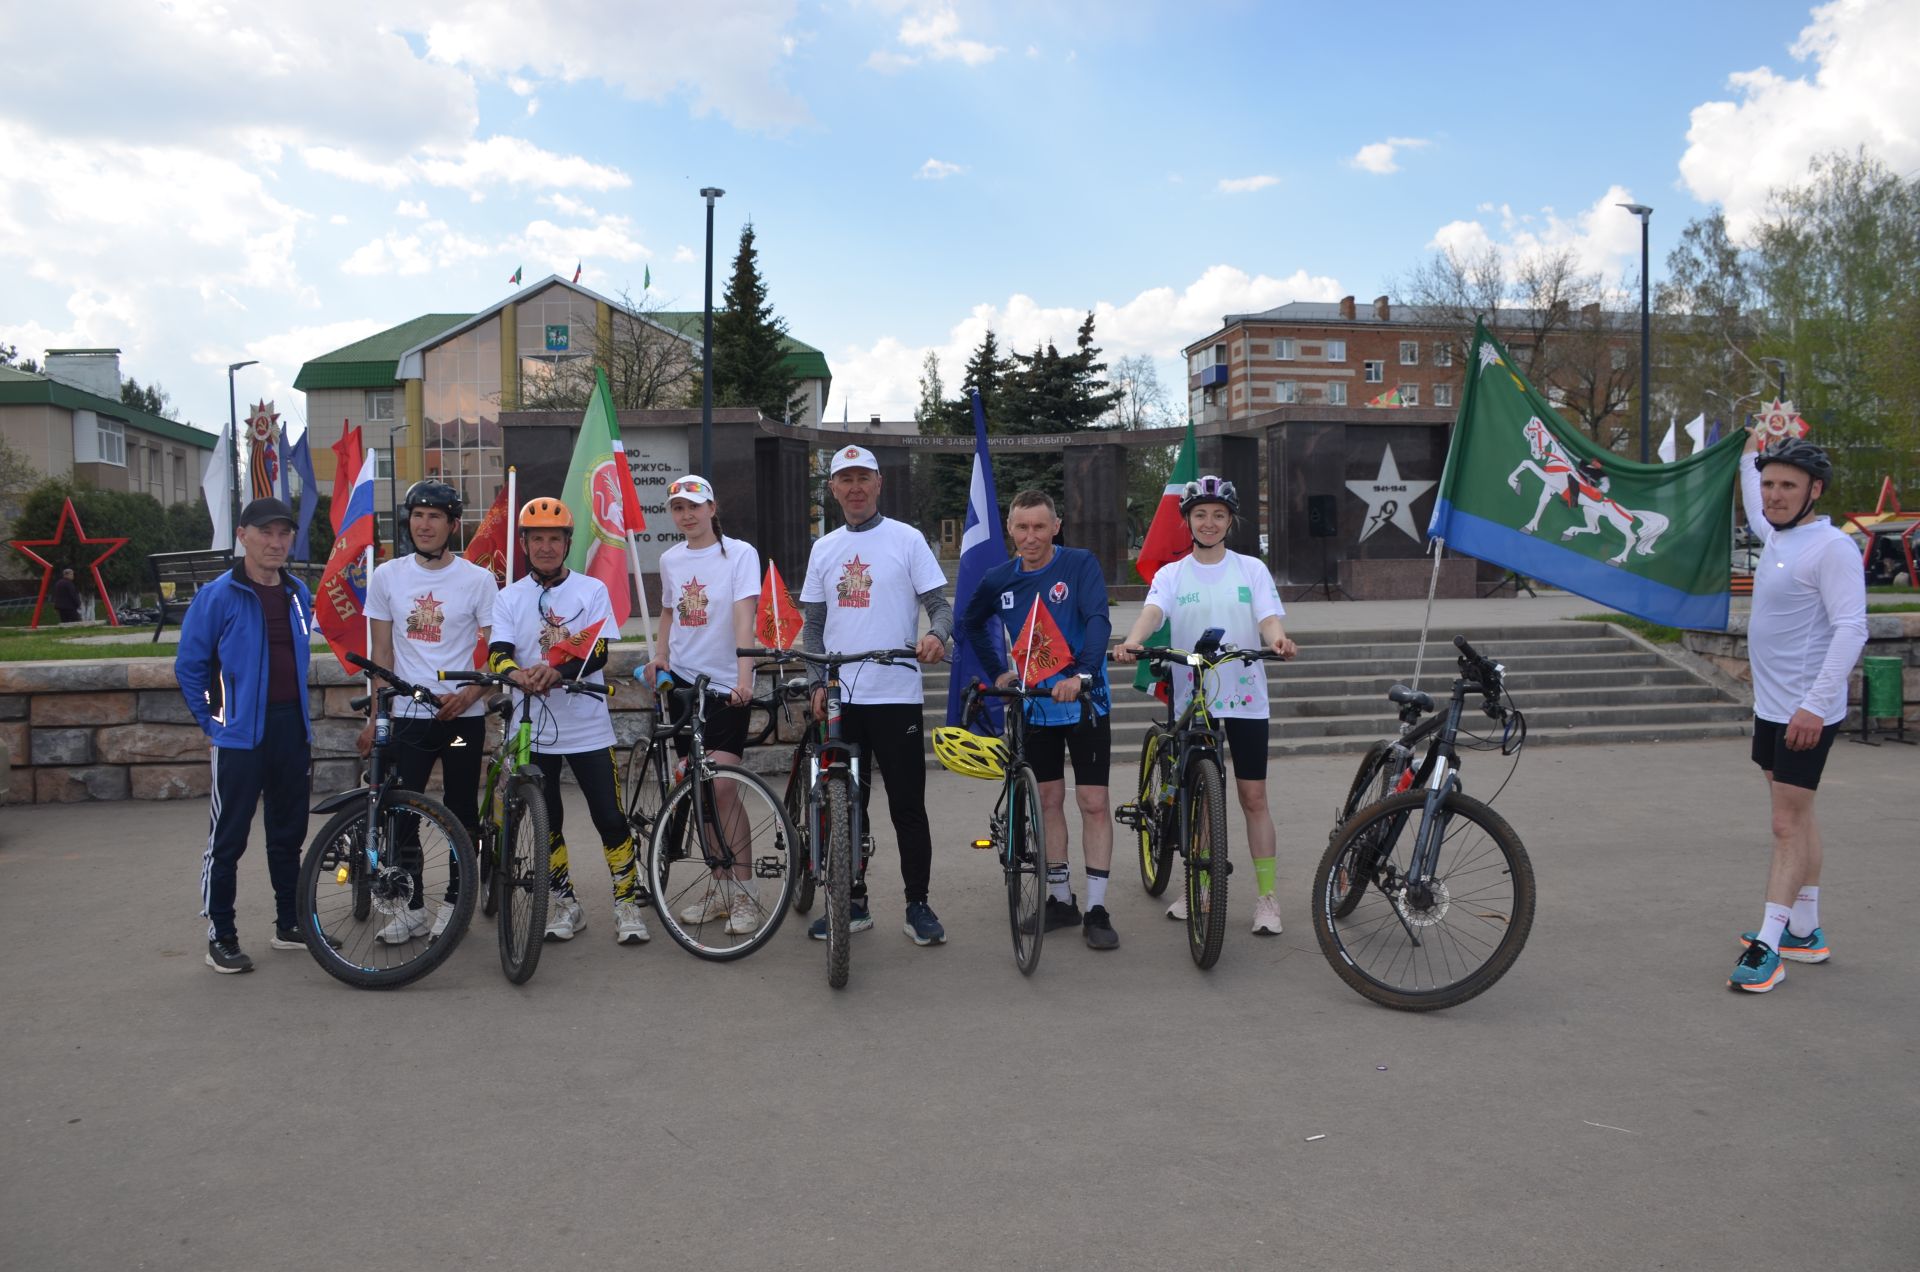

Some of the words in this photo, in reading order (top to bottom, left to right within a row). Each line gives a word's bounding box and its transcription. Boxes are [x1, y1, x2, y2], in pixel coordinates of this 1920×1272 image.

[902, 437, 930, 445] НИКТО
[933, 437, 944, 445] НЕ
[1017, 437, 1029, 445] НЕ
[628, 463, 682, 472] ОРЖУСЬ...
[633, 477, 666, 486] ОНЯЮ
[657, 533, 686, 543] ОГНЯ
